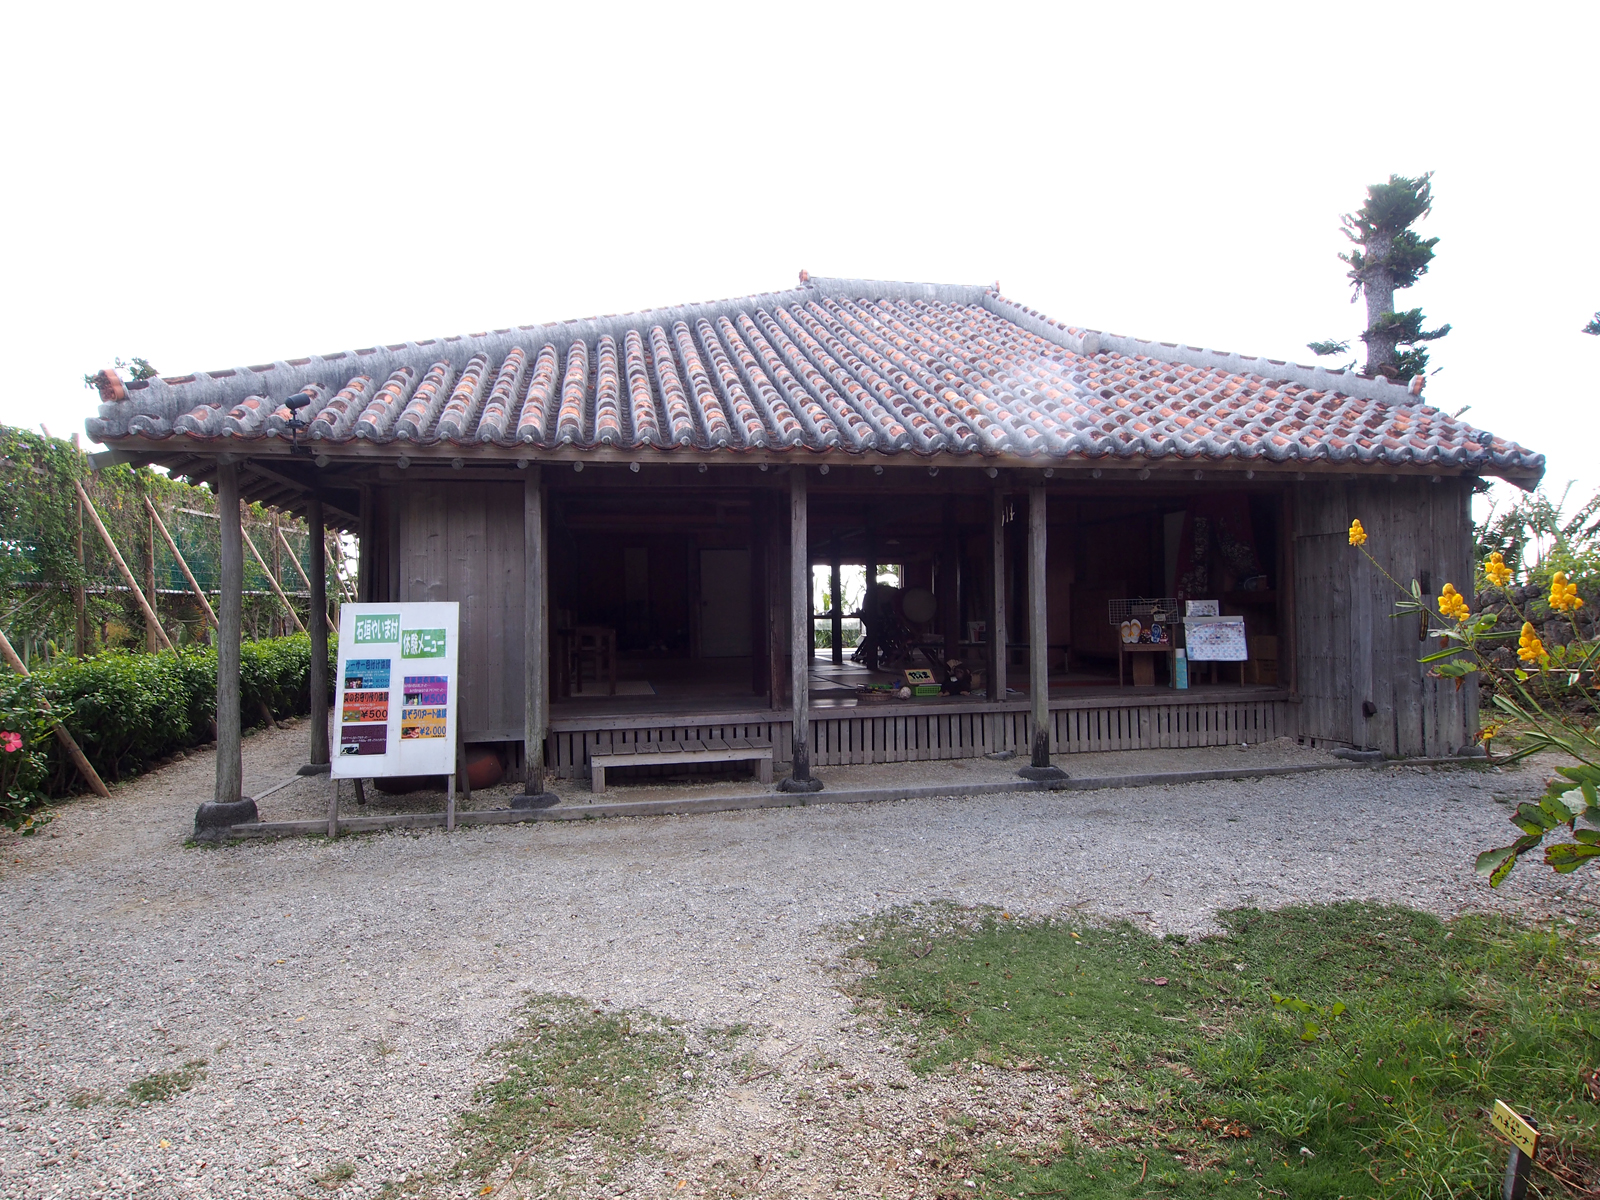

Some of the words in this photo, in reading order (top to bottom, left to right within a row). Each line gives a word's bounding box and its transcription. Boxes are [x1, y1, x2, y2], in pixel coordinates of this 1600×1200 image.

[357, 618, 398, 641] 石垣やいま村
[403, 633, 444, 656] 体験メニュー
[424, 694, 447, 704] ¥500
[360, 709, 388, 719] ¥500
[420, 726, 447, 736] ¥2,000
